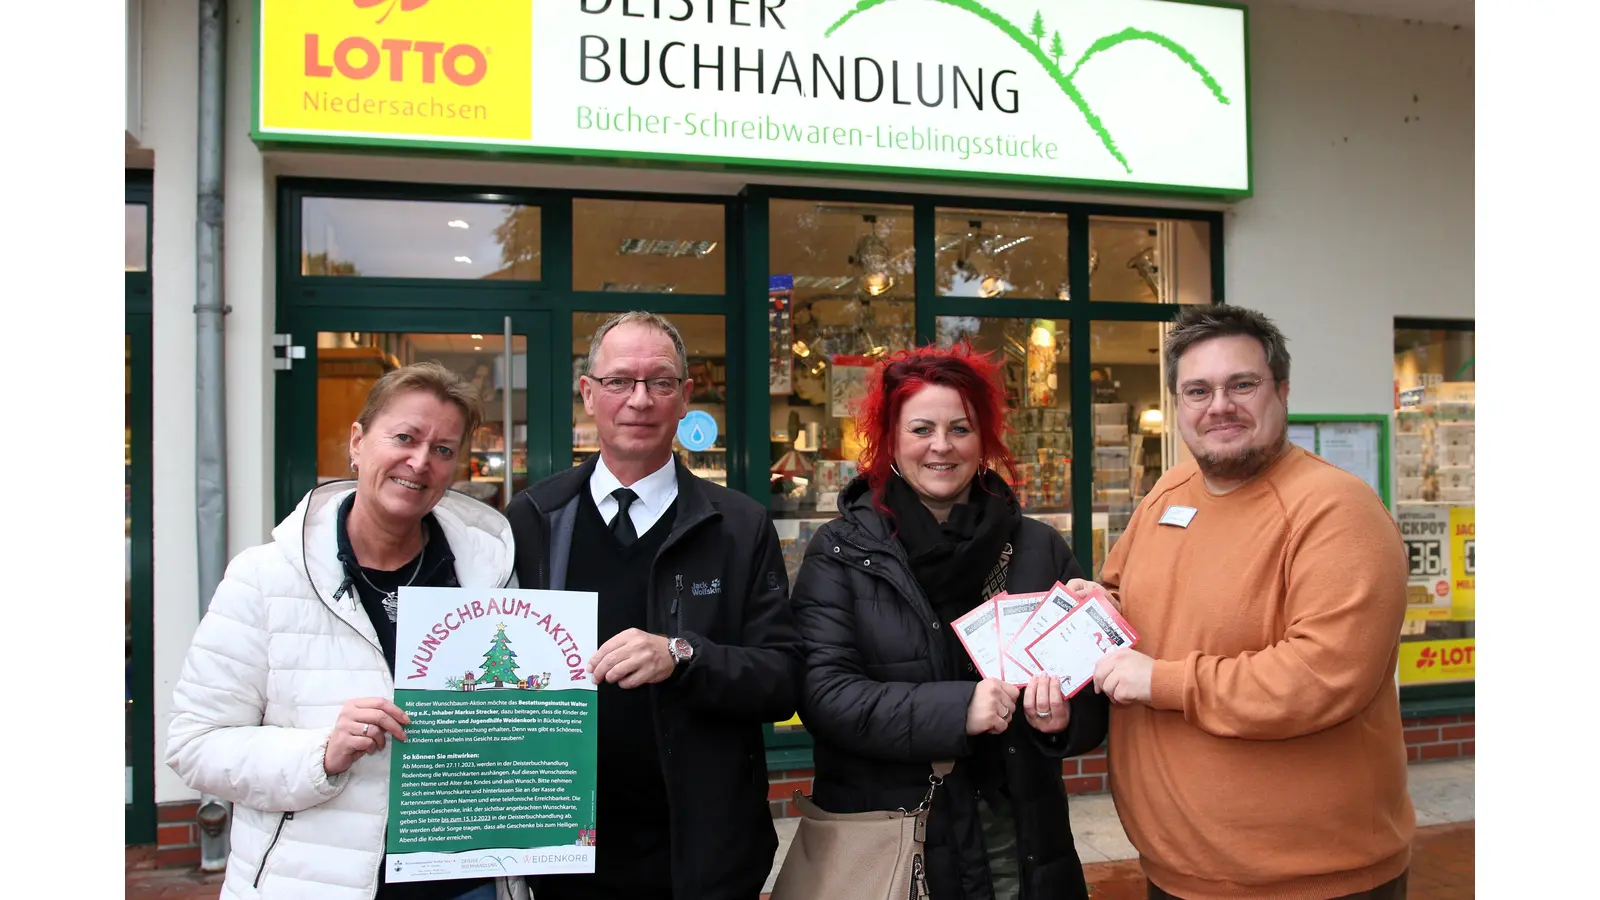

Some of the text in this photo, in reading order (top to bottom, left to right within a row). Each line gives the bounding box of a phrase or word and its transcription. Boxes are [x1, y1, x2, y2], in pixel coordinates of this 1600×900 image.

[304, 33, 488, 87] LOTTO
[579, 34, 1020, 114] BUCHHANDLUNG
[303, 91, 488, 120] Niedersachsen
[577, 105, 1059, 161] Bücher-Schreibwaren-Lieblingsstücke
[1396, 522, 1447, 535] CKPOT
[1405, 542, 1440, 574] 36
[692, 588, 721, 596] Wolfskin
[407, 598, 586, 682] WUNSCHBAUM-AKTION
[1441, 645, 1475, 666] LOT
[518, 700, 570, 708] Bestattungsinstitut
[421, 727, 487, 735] Weihnachtsüberraschung
[400, 818, 417, 826] geben
[508, 813, 564, 821] Deisterbuchhandlung
[446, 825, 462, 833] Sorge
[523, 854, 588, 864] WEIDENKORB
